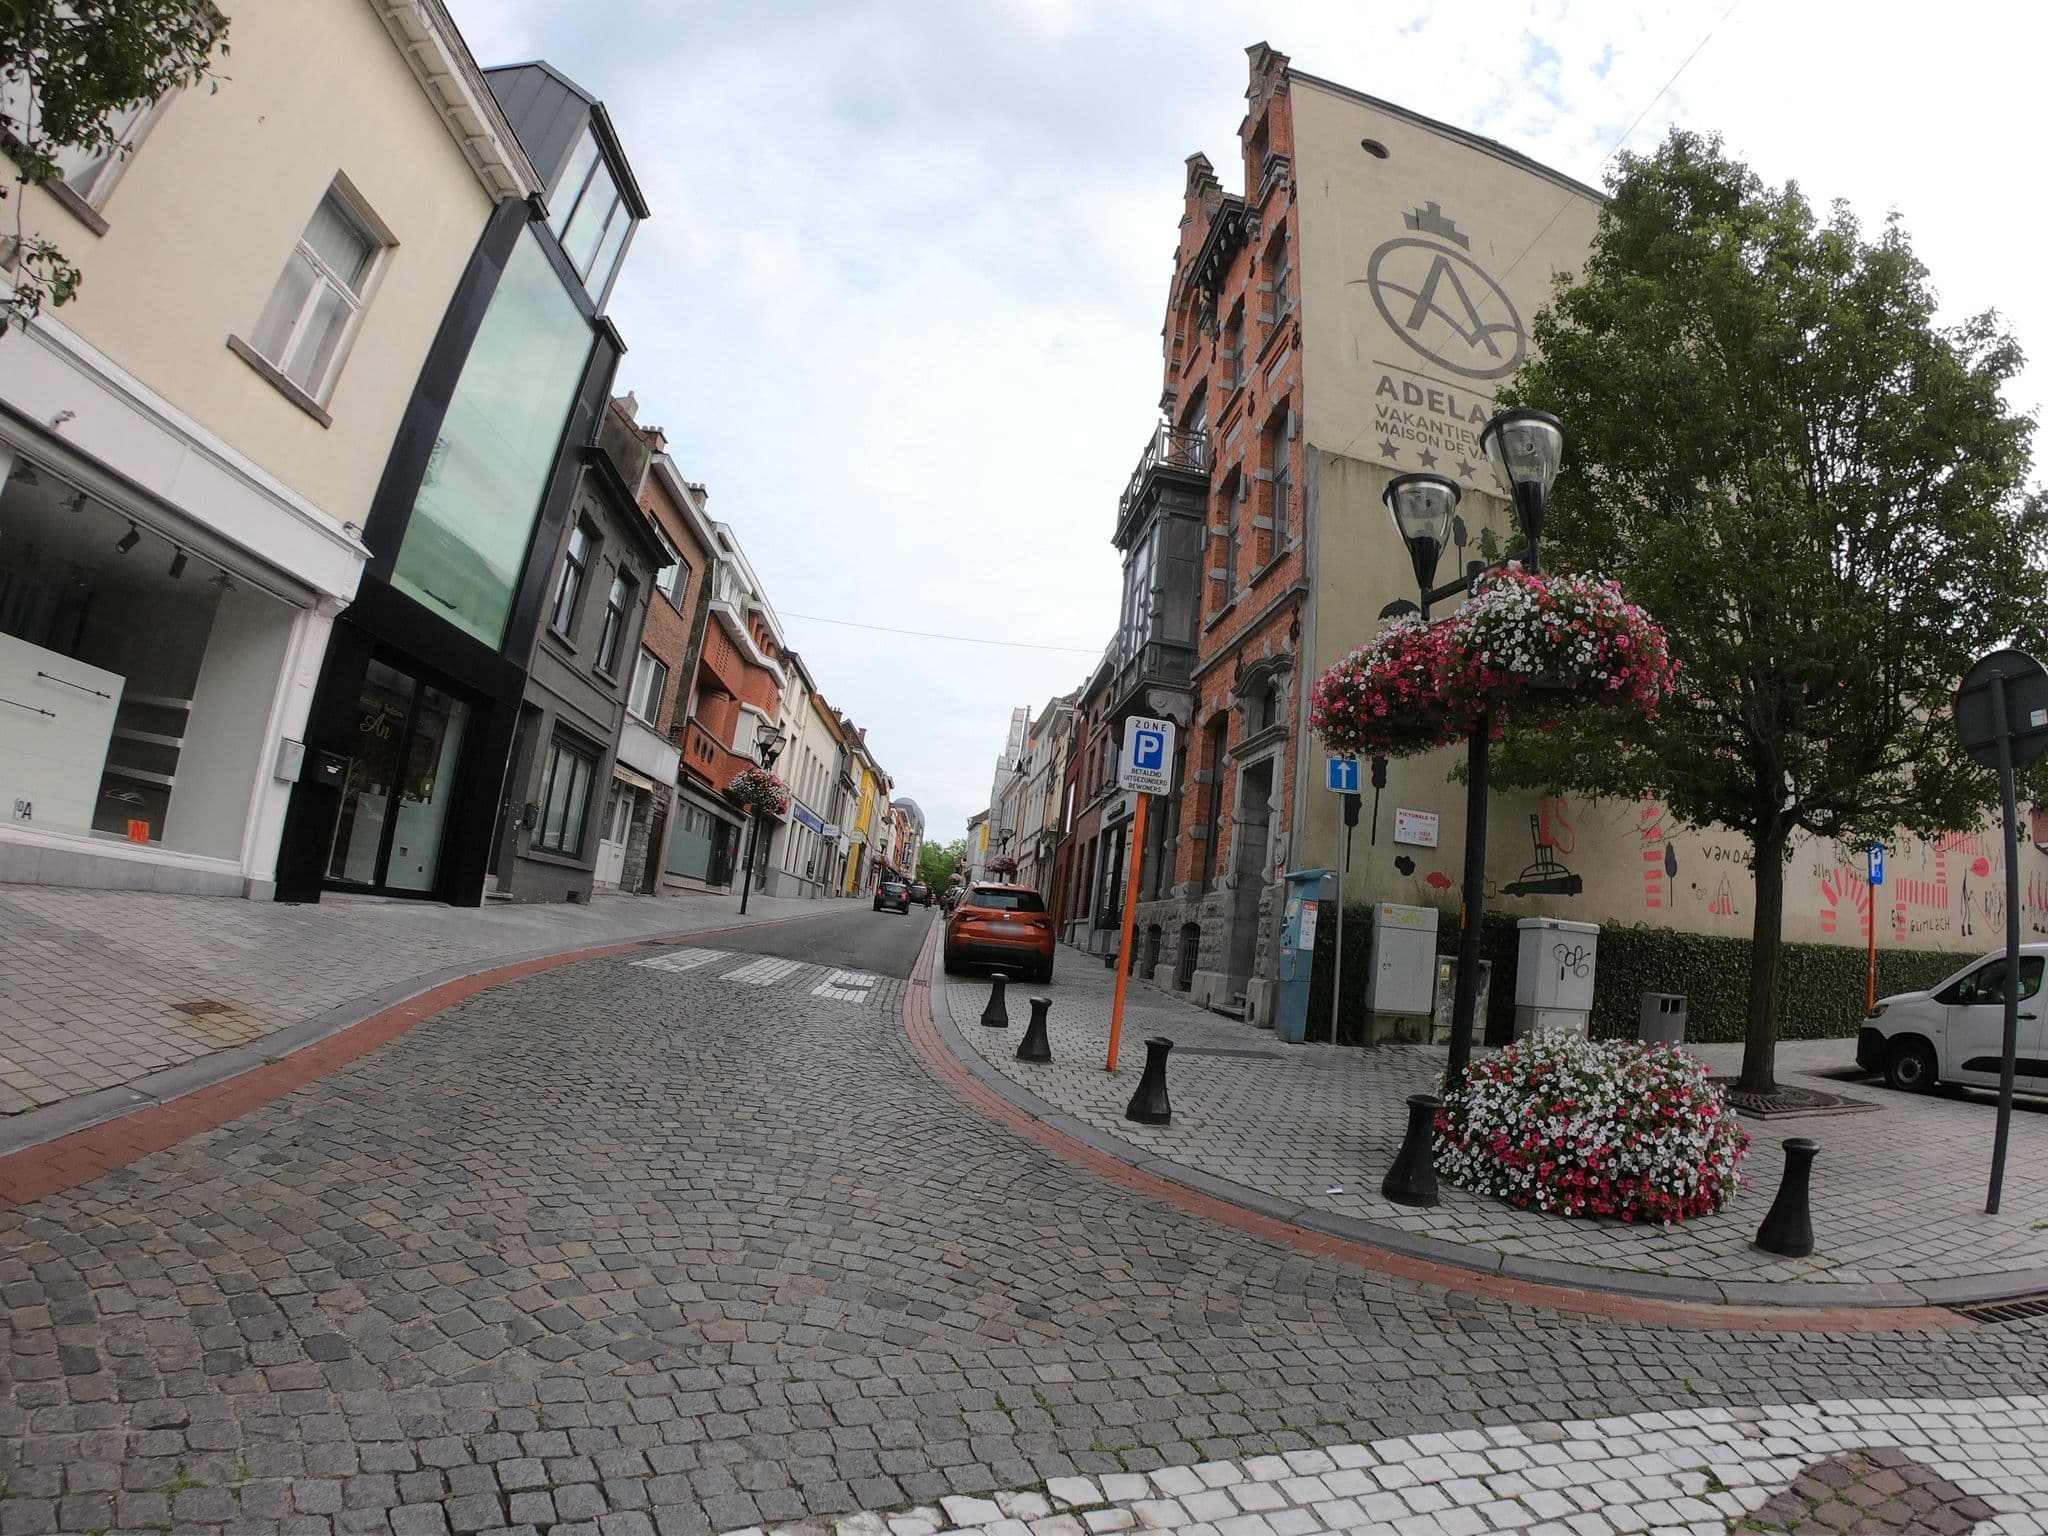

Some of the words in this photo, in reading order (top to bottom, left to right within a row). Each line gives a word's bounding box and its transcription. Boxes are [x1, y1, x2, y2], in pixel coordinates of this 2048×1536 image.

[1375, 420, 1440, 449] MAISON
[1444, 439, 1466, 455] DE
[1135, 720, 1167, 732] ZONE
[1137, 734, 1159, 763] P
[1131, 767, 1162, 778] BETALEND
[1123, 774, 1168, 786] UITGEZONDERD
[1128, 783, 1162, 793] BEWONERS
